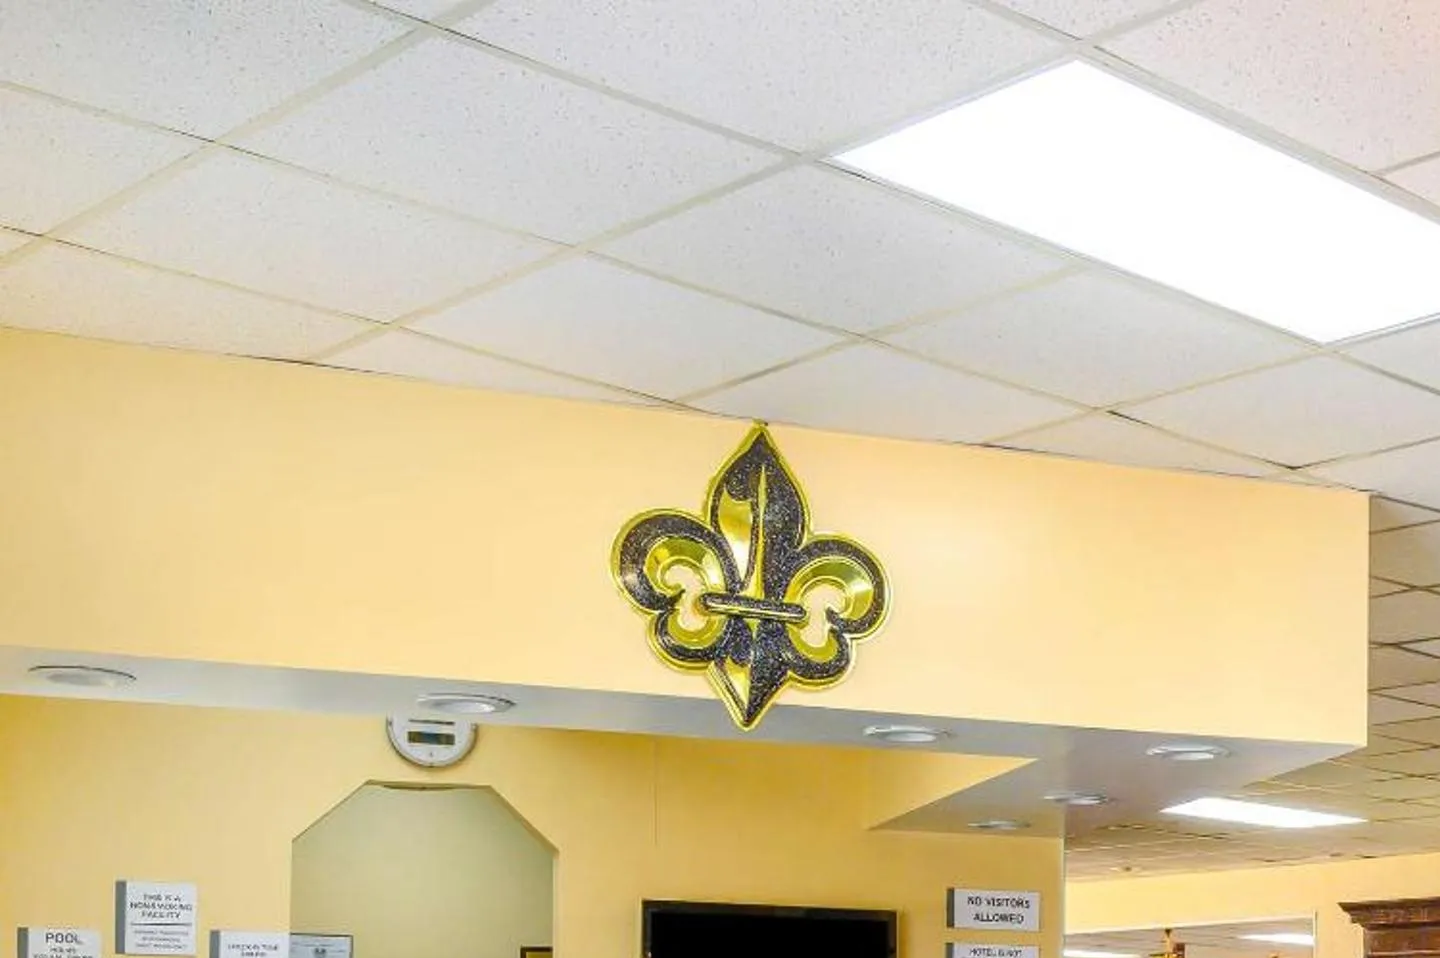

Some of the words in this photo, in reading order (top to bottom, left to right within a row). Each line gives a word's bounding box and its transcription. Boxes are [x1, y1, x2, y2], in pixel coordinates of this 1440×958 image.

[967, 896, 981, 906] NO
[985, 897, 1030, 909] VISITORS
[973, 913, 1024, 924] ALLOWED
[45, 932, 82, 944] POOL
